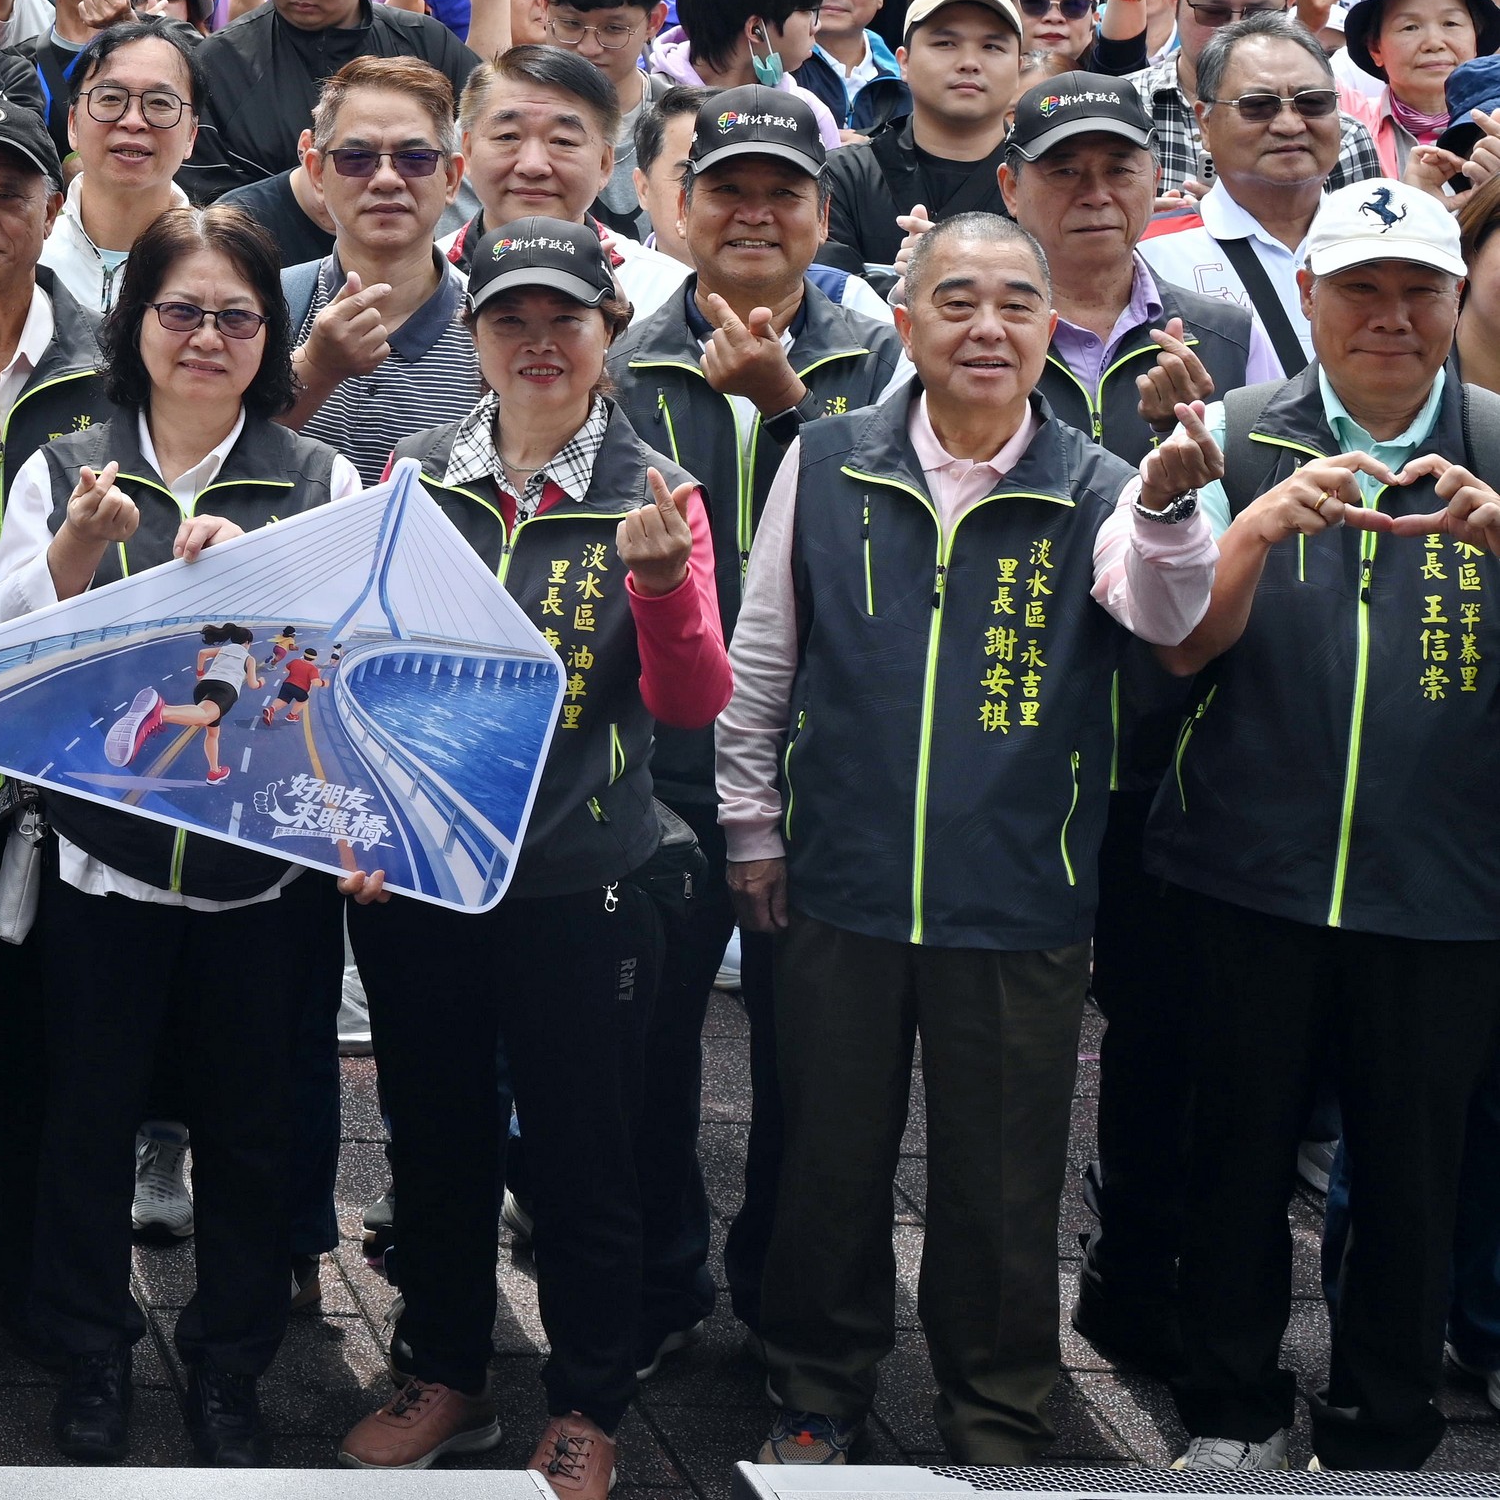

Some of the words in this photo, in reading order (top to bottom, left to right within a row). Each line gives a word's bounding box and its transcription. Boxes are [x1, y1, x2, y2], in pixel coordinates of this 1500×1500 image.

[737, 112, 799, 133] 新北市政府
[1059, 90, 1121, 108] 新北市政府
[510, 238, 576, 256] 新北市政府
[540, 559, 571, 616] 里長
[573, 542, 609, 632] 淡水區
[990, 557, 1019, 615] 里長
[1025, 538, 1054, 628] 淡水區
[977, 625, 1019, 735] 謝安棋
[1018, 639, 1048, 727] 永吉里
[1419, 594, 1451, 701] 王信崇
[561, 644, 595, 730] 油車里
[283, 773, 375, 813] 好朋友
